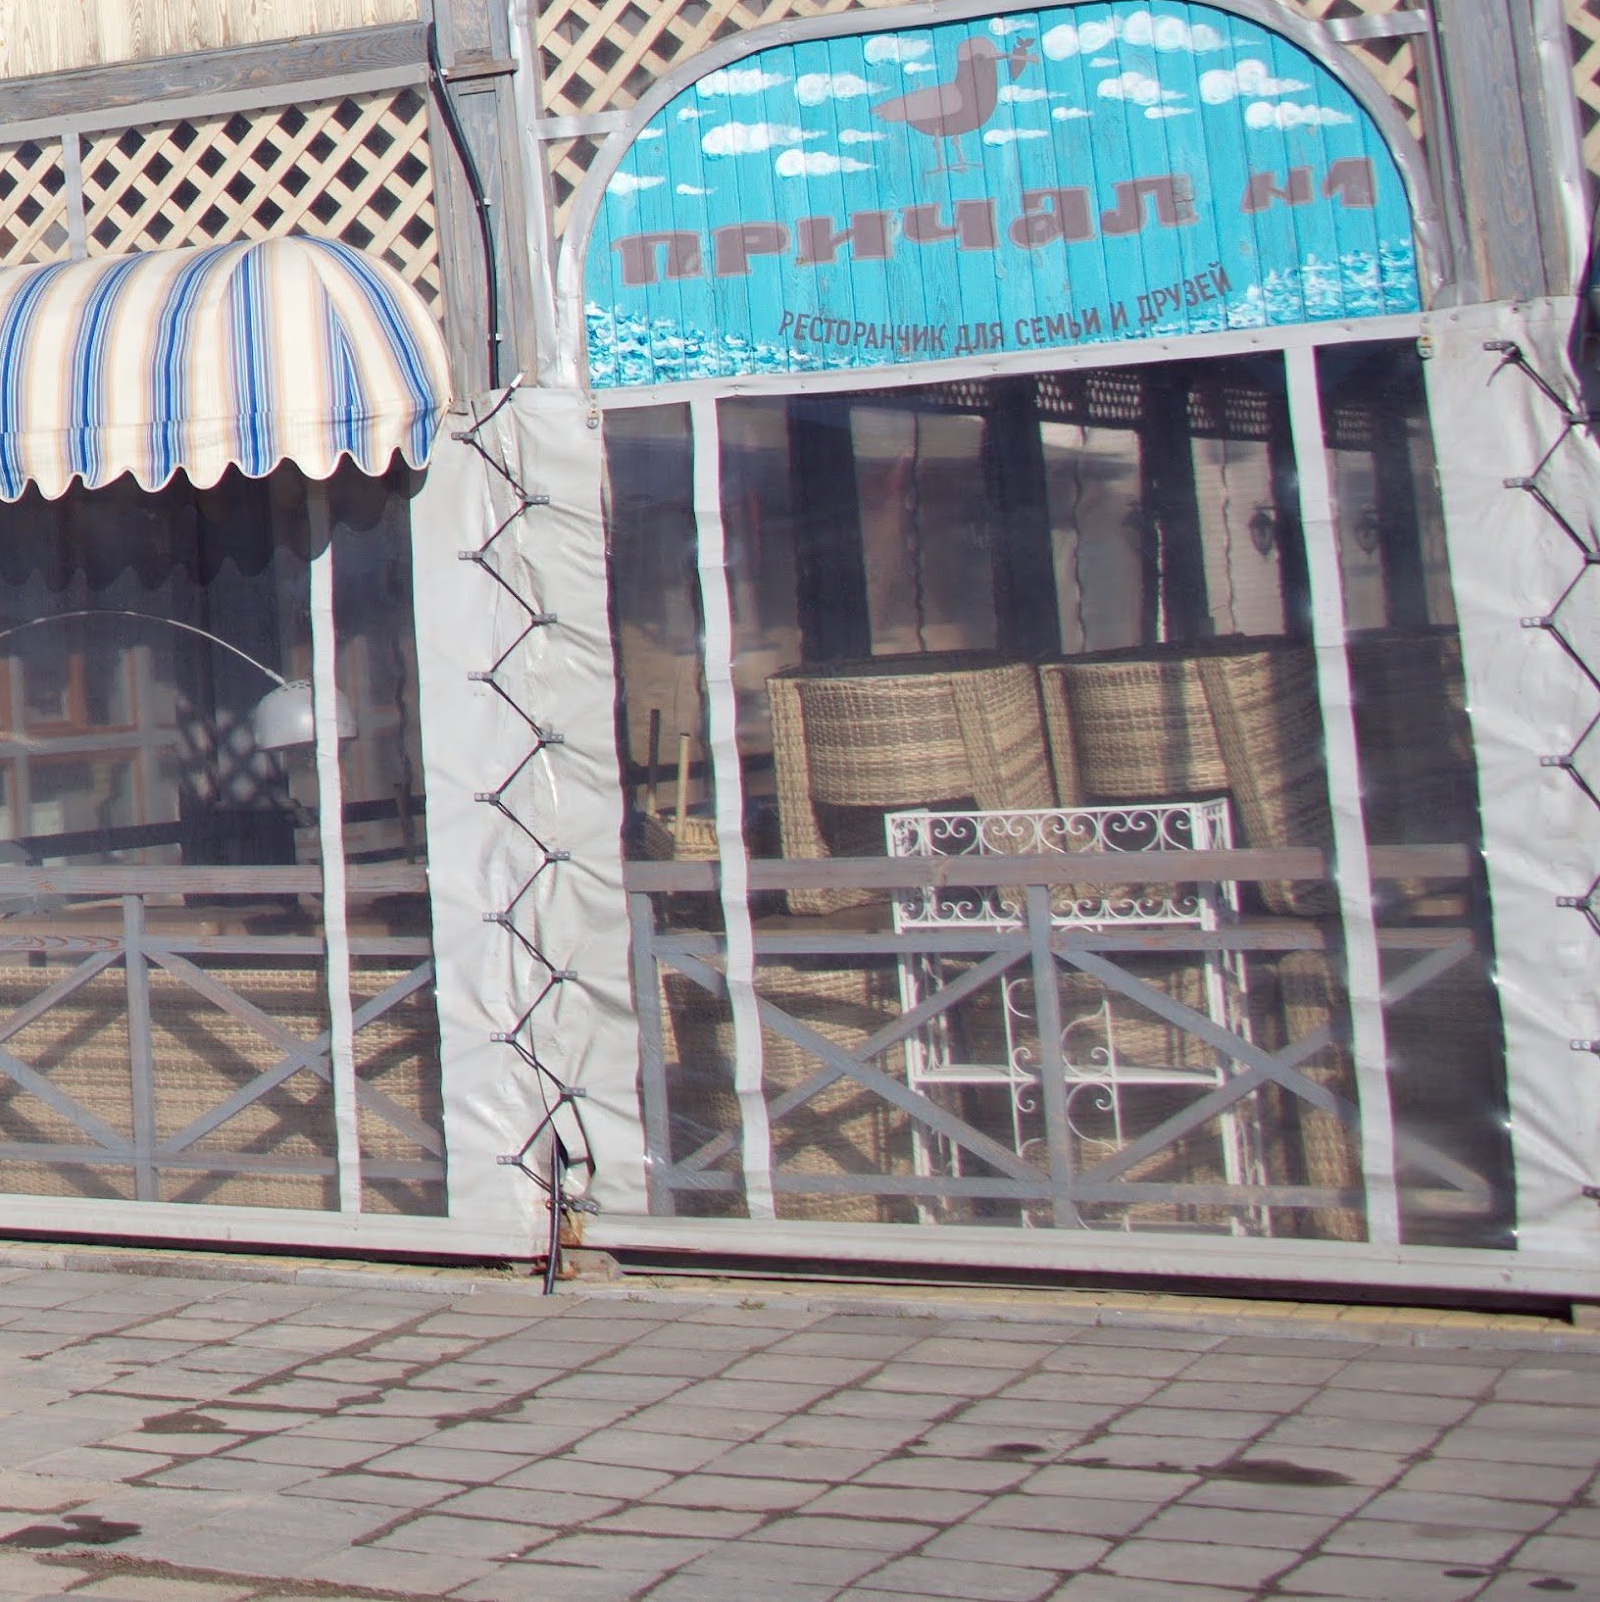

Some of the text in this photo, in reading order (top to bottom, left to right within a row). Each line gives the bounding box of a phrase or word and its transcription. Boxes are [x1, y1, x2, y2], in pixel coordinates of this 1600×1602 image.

[778, 261, 1233, 353] РЕСТОРАНЧИК ДЛЯ СЕМЬИ И ДРУЗЕЙ
